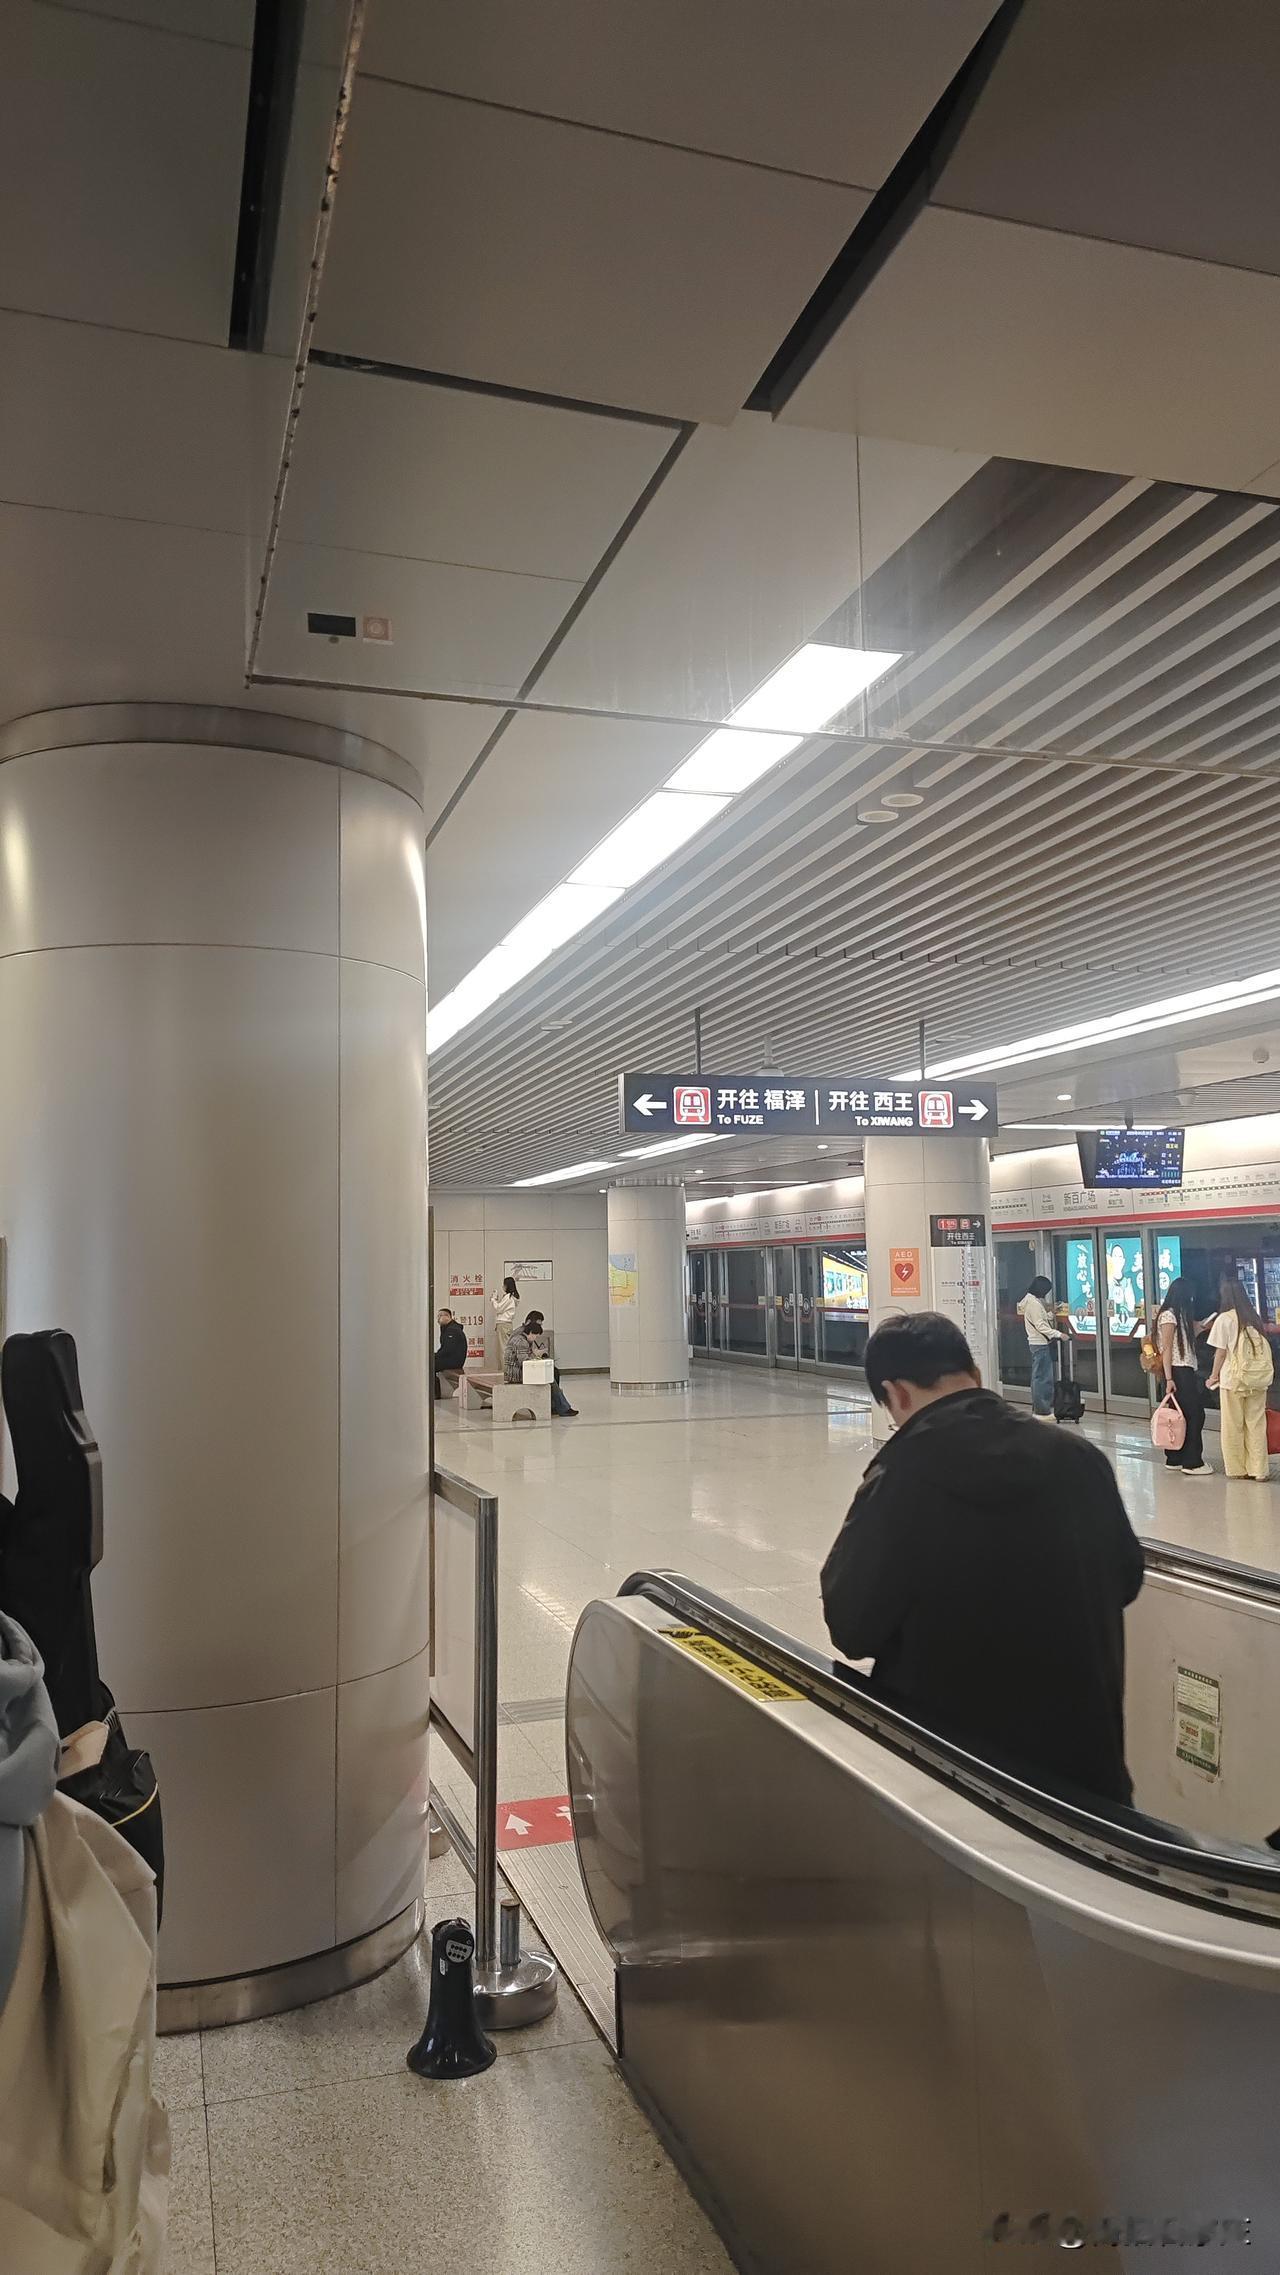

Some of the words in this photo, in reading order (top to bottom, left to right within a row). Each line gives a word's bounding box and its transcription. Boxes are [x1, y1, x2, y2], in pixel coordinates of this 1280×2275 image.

[717, 1089, 759, 1110] 开往
[764, 1089, 806, 1111] 福泽
[829, 1091, 869, 1111] 开往
[873, 1091, 914, 1112] 西王
[717, 1115, 732, 1125] To
[733, 1115, 764, 1125] FUZE
[855, 1116, 869, 1126] To
[870, 1116, 914, 1127] XIWANG
[450, 1274, 483, 1283] 消火栓
